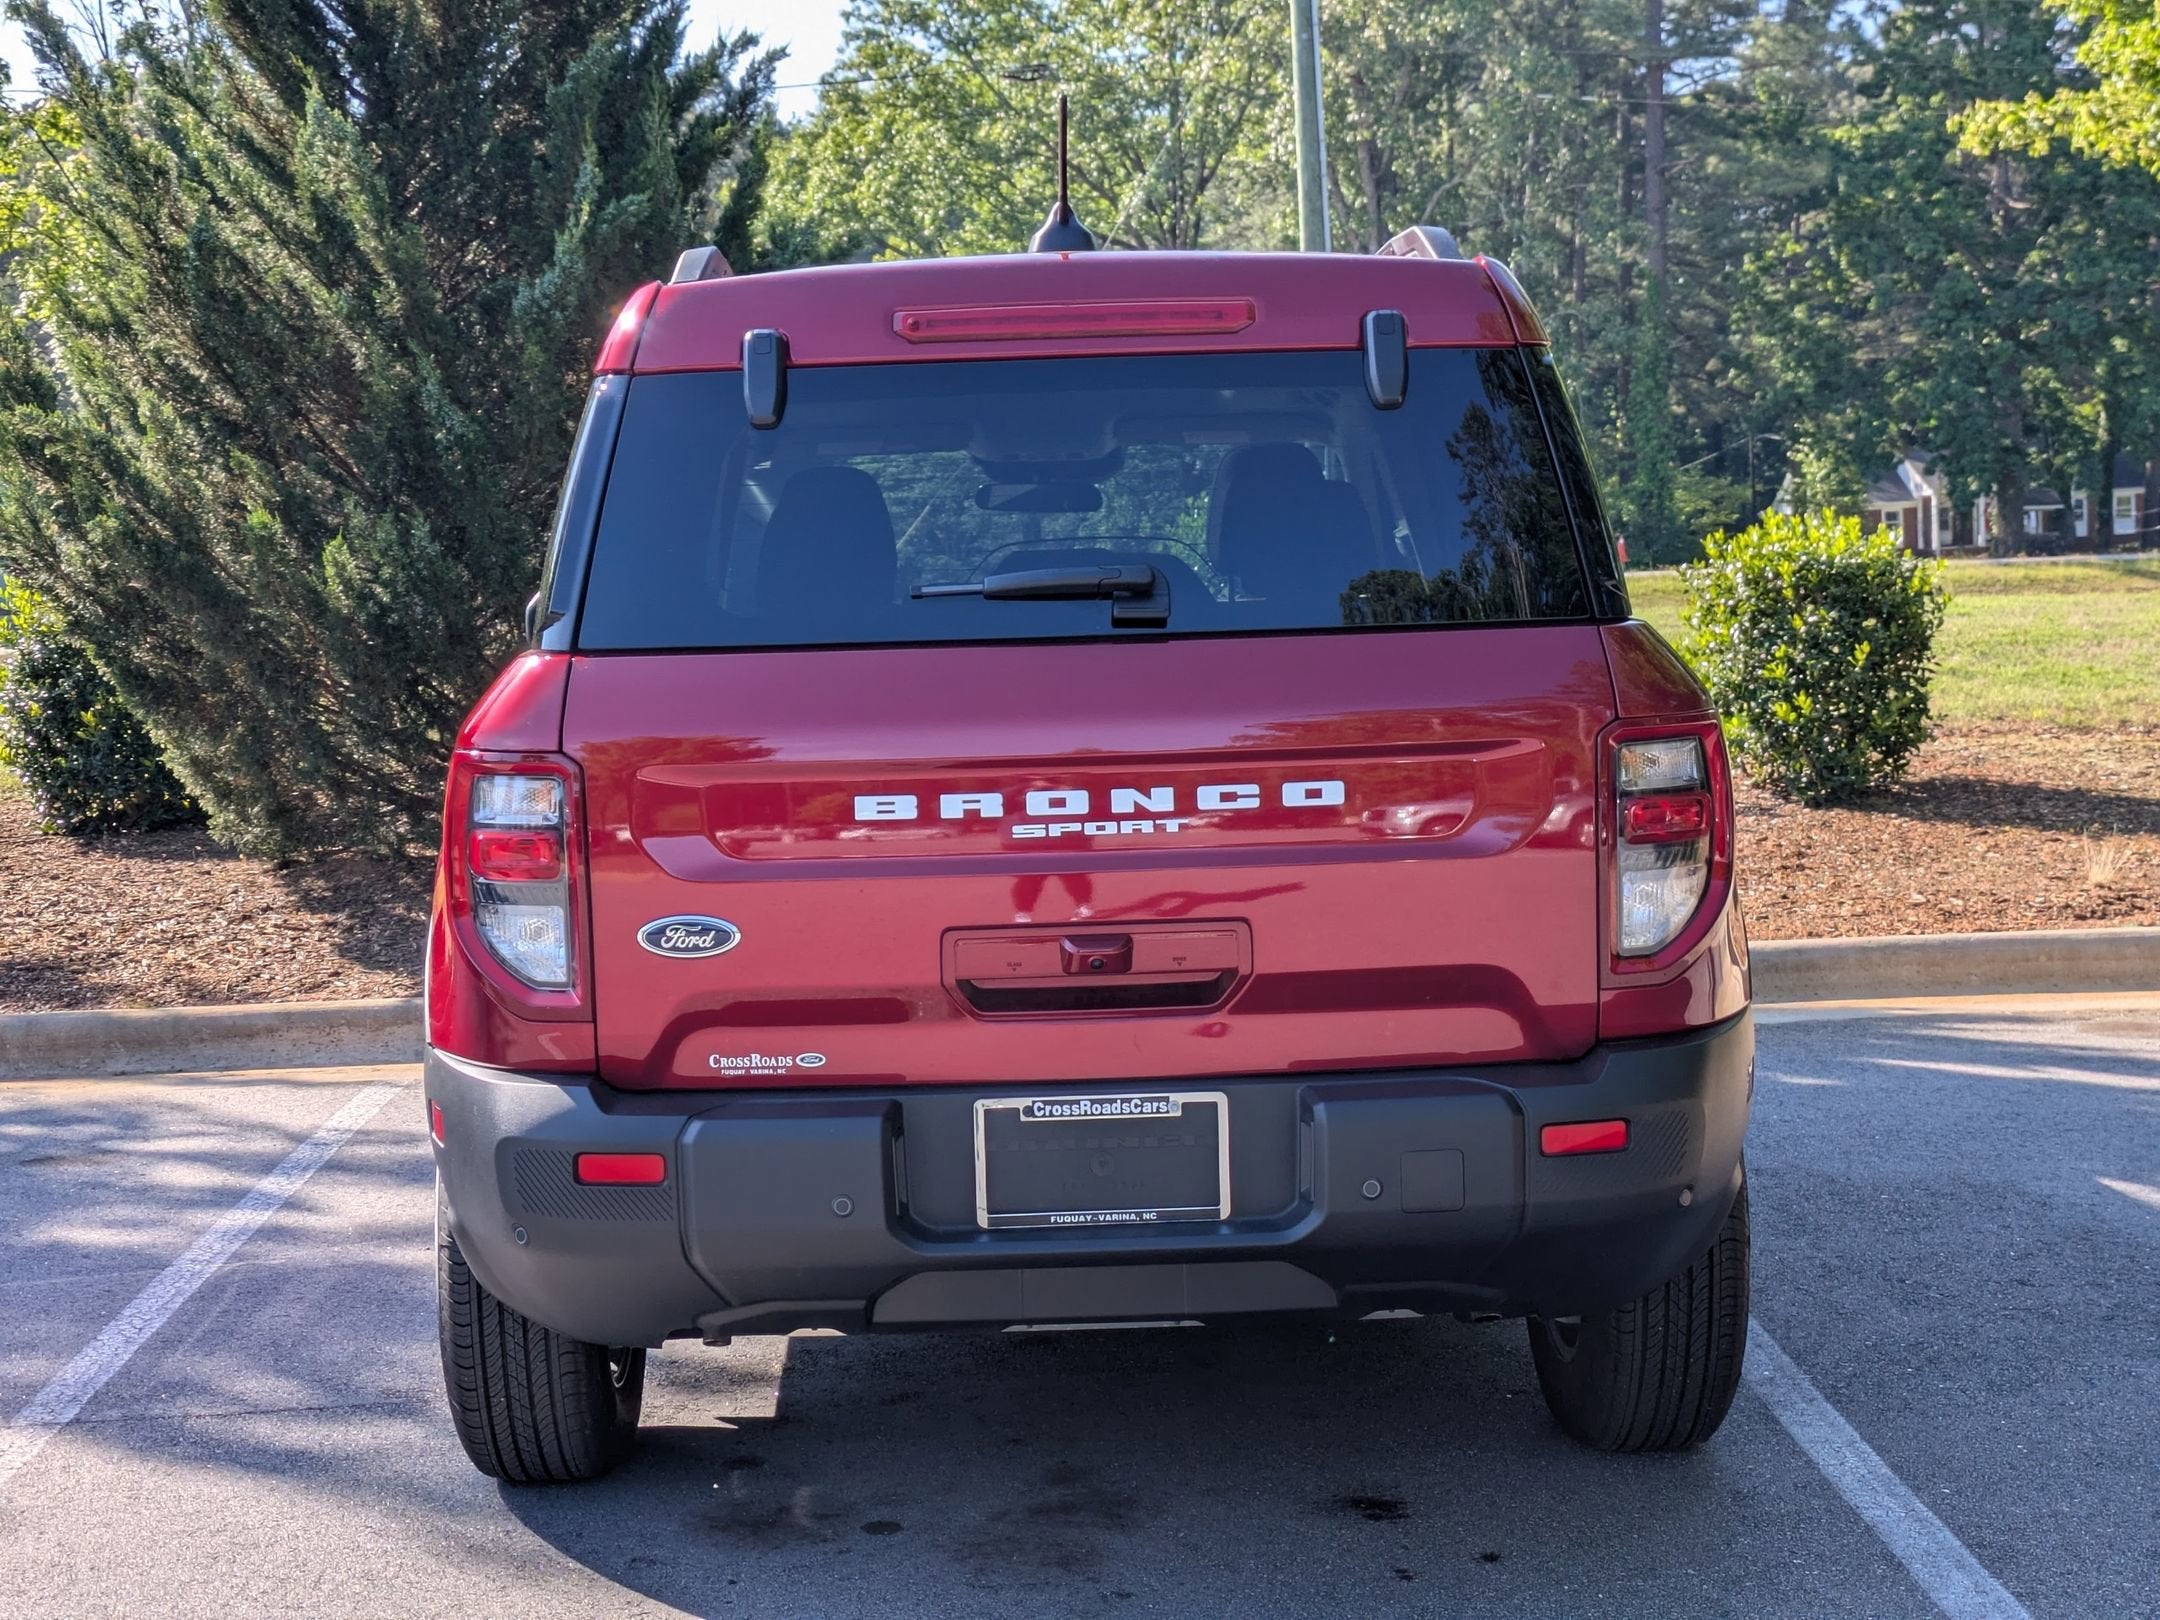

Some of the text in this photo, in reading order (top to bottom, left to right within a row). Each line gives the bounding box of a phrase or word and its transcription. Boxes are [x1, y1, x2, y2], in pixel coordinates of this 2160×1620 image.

[854, 780, 1345, 820] BRONCO
[1012, 819, 1189, 838] SPORT
[661, 924, 716, 949] Ford
[1033, 1098, 1168, 1117] CrossRoadsCars
[1050, 1212, 1158, 1223] FUQUAY-VARINA, NC
